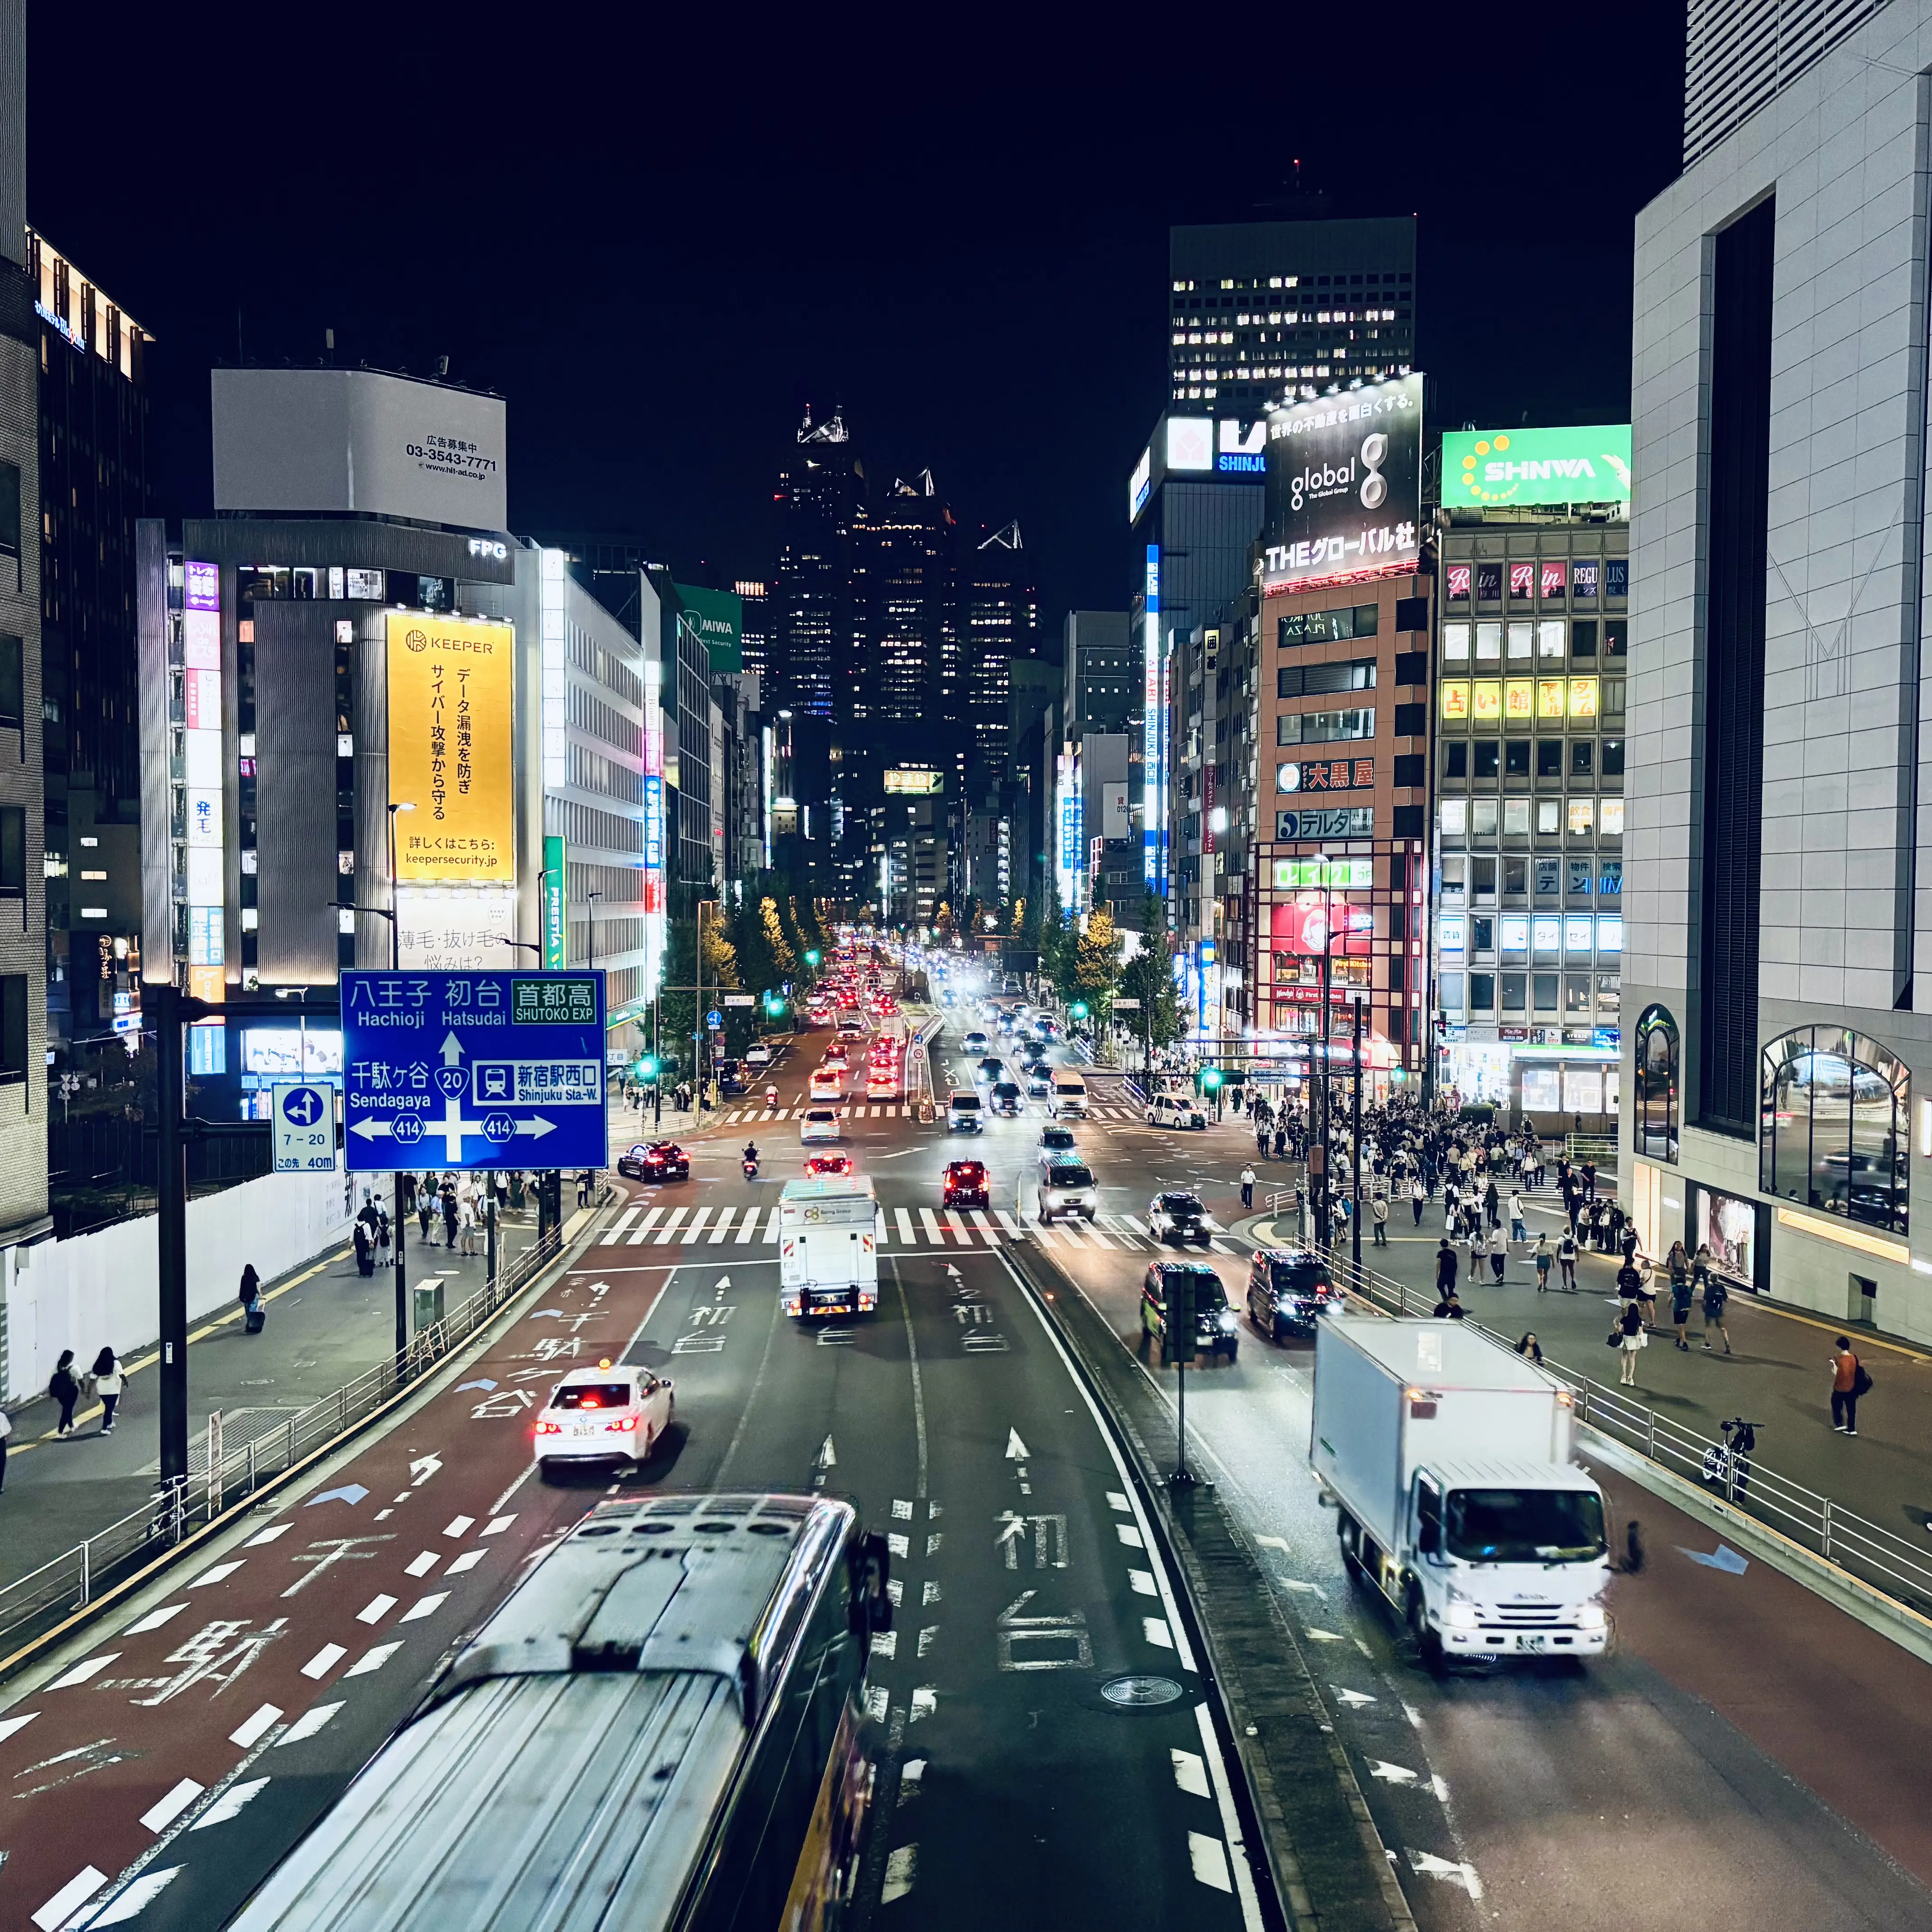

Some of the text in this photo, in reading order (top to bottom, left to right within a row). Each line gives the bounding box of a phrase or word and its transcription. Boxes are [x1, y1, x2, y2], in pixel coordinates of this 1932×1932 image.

[1270, 392, 1413, 440] 世界の不動産を面白くする。
[427, 435, 477, 454] 広告募集中
[406, 444, 496, 471] 03-3543-7771
[426, 463, 485, 481] www.hit-ad.co.jp
[1485, 458, 1596, 482] SHINWA
[1291, 456, 1355, 511] global
[1309, 487, 1348, 500] The Global Group
[469, 539, 507, 559] FPG
[1265, 521, 1415, 572] THEグローバル社
[189, 565, 215, 576] トレカ
[702, 619, 733, 635] MIWA
[431, 636, 493, 654] KEEPER
[1147, 670, 1156, 702] LABI
[456, 668, 472, 794] データ漏洩を防ぎ
[1147, 708, 1156, 757] SHINJUKU
[431, 664, 446, 820] サイバー攻撃から守る
[888, 772, 927, 785] やまや
[1309, 759, 1373, 789] 大黒屋
[196, 800, 212, 833] 発毛
[1302, 813, 1349, 835] デルタ
[409, 836, 495, 851] 詳しくはこちら:
[406, 853, 497, 867] keepersecurity.jp
[397, 929, 509, 949] 薄毛・抜け毛の
[350, 979, 591, 1007] 八王子 初台 首都高
[358, 1008, 593, 1029] Hachioji Hatsudai SHUTOKO EXP
[442, 1072, 462, 1089] 20
[517, 1064, 596, 1087] 新宿駅西口
[350, 1092, 431, 1110] Sendagaya
[519, 1088, 562, 1103] Shinjuku
[396, 1120, 510, 1135] 414 414
[277, 1157, 332, 1168] この先 40m
[671, 1306, 738, 1354] 初台
